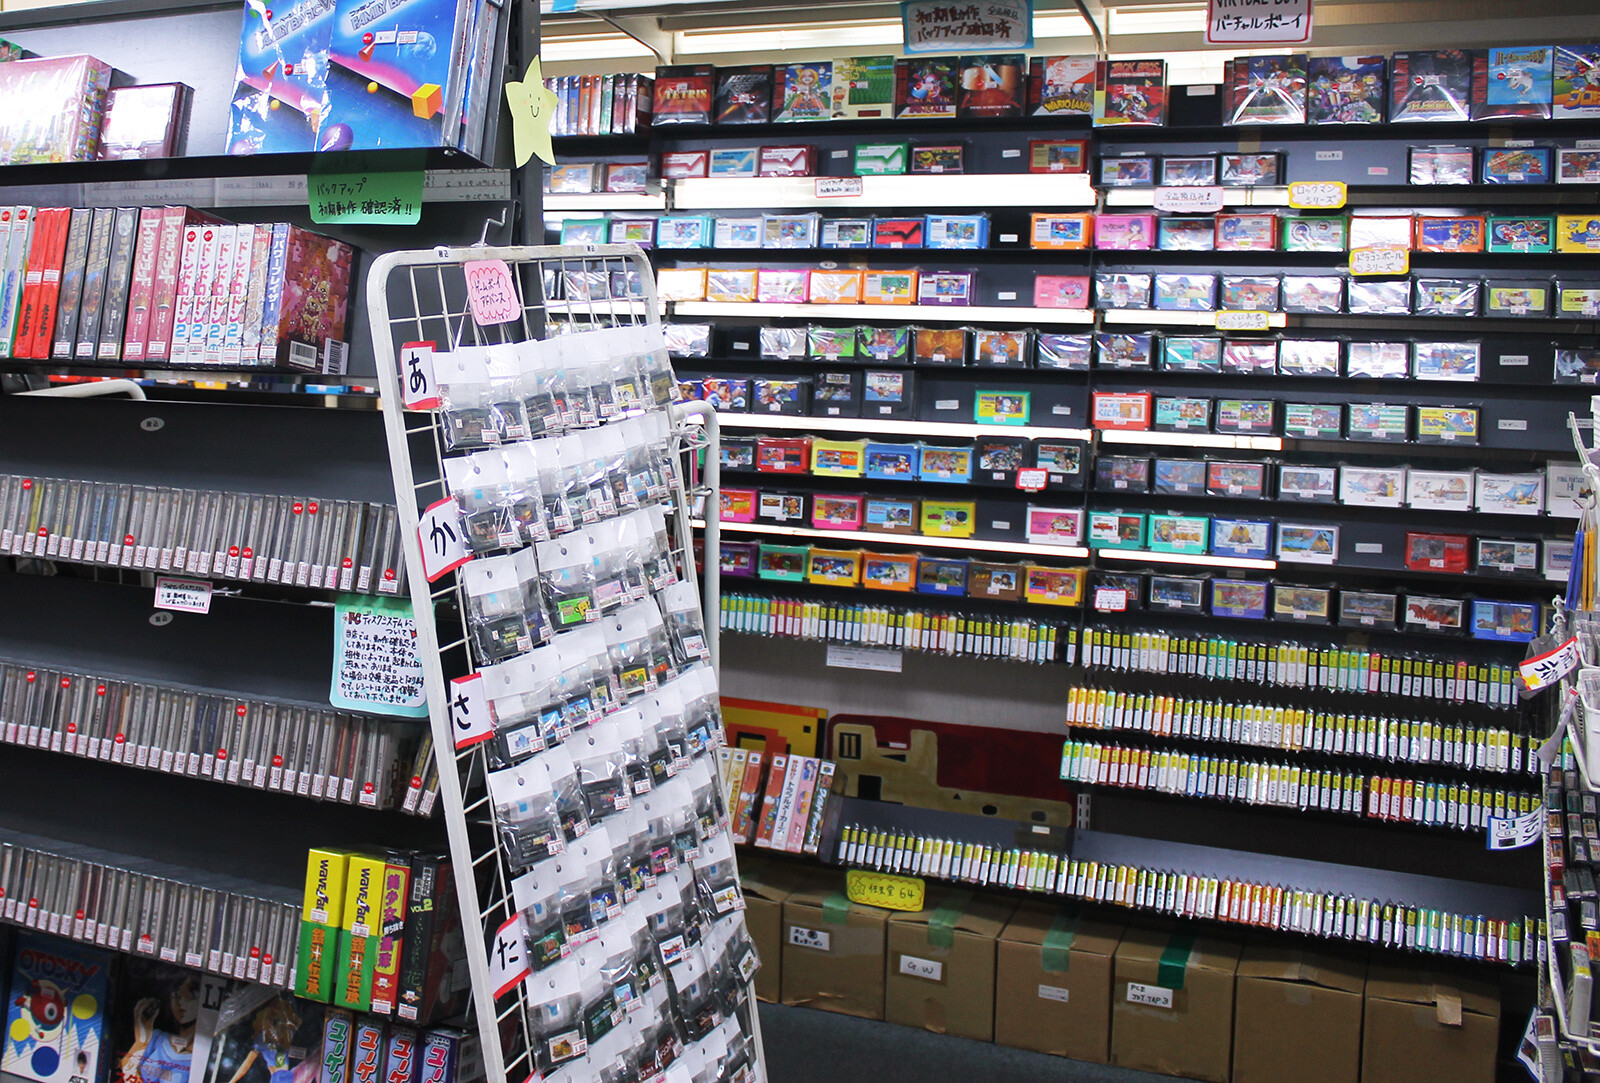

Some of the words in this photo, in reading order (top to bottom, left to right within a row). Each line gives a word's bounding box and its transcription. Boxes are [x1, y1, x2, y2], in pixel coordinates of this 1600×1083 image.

[1216, 13, 1303, 32] バーチャルボーイ
[665, 88, 707, 100] TETRIS
[1043, 99, 1072, 114] WARIO
[1070, 98, 1092, 113] LAND
[317, 177, 368, 196] バックアップ
[1297, 186, 1334, 195] ロックマン
[1306, 195, 1337, 205] シリーズ
[1356, 251, 1404, 262] ドラゴンボール
[1366, 262, 1394, 272] シリーズ
[268, 240, 284, 311] パワーブレイザー
[474, 279, 501, 293] ゲームボーイ
[480, 292, 506, 307] アドバンス
[1238, 321, 1266, 329] シリーズ
[408, 351, 427, 394] あ
[430, 516, 456, 556] か
[385, 628, 407, 637] ついて
[453, 693, 471, 730] さ
[1520, 813, 1540, 844] MSX
[899, 887, 915, 899] 64
[497, 936, 519, 971] た
[1132, 994, 1146, 1002] JOY
[1161, 996, 1169, 1005] 3
